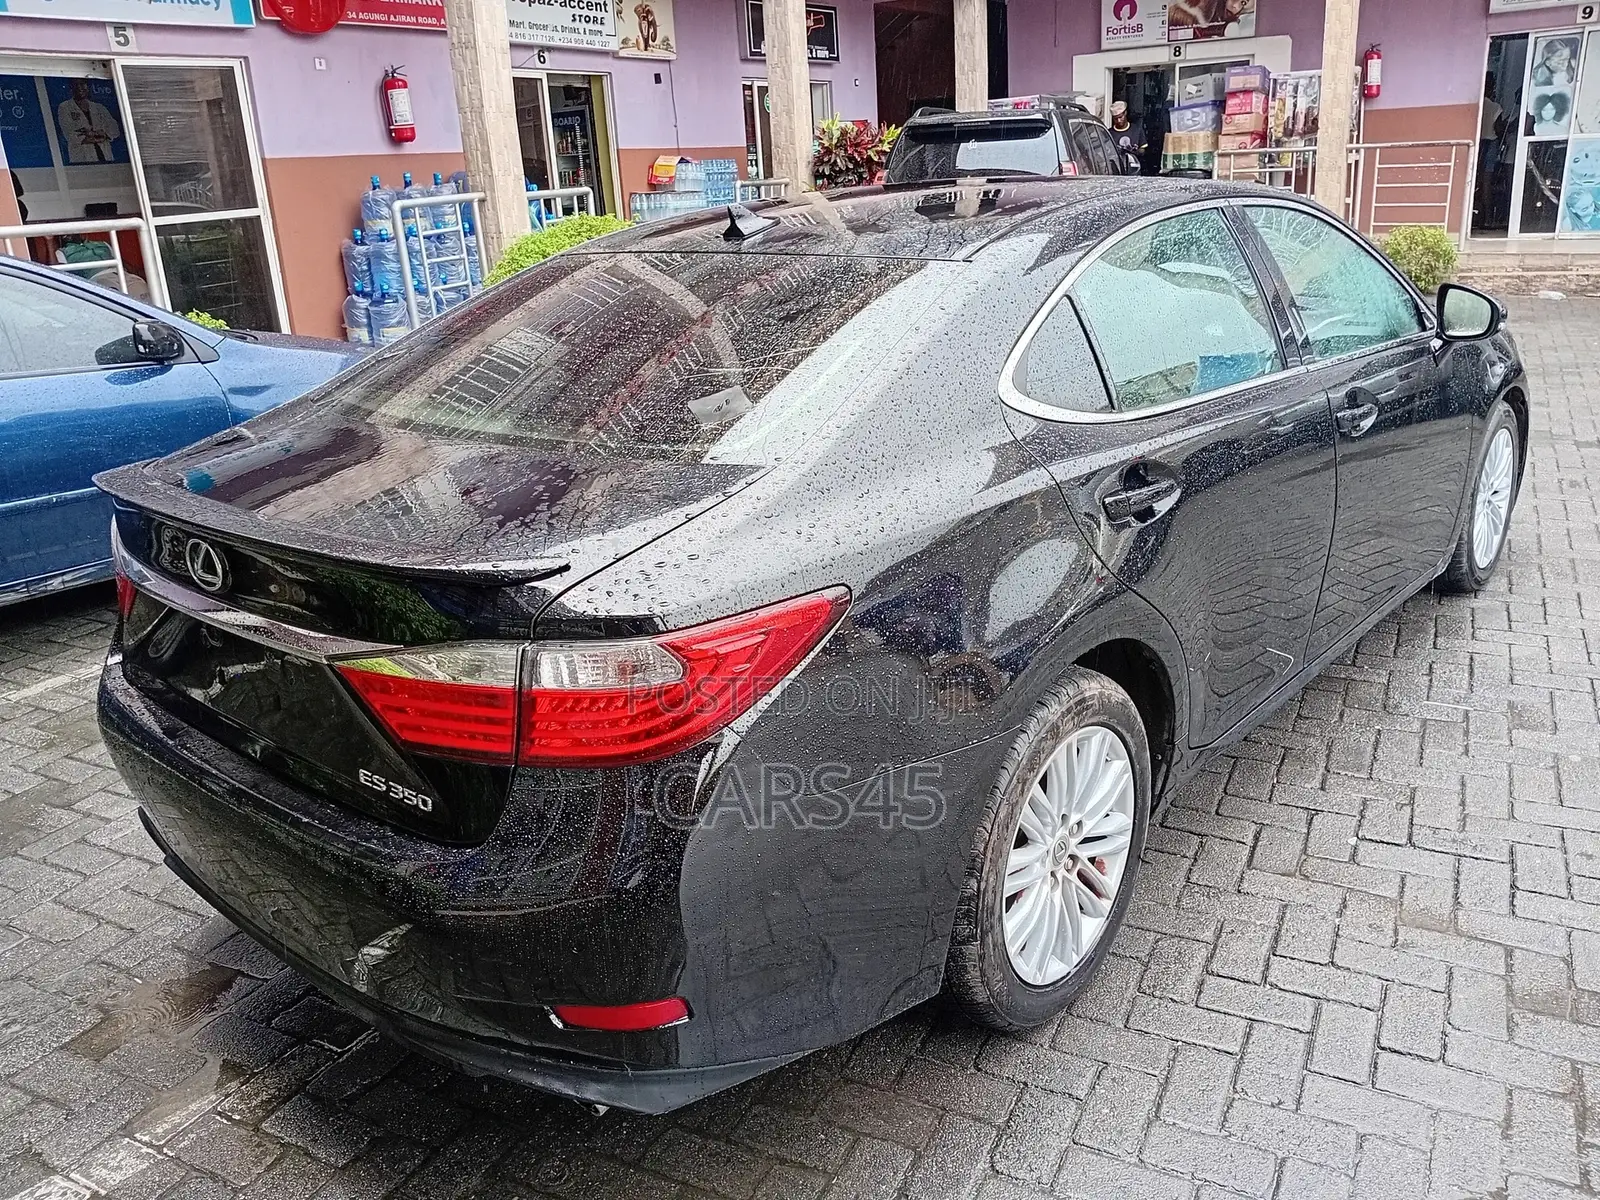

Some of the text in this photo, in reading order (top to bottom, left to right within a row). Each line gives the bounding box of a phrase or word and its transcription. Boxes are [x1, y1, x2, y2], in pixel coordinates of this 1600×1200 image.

[512, 0, 608, 13] paz-accent
[1581, 5, 1594, 20] 9
[346, 11, 357, 19] 34
[358, 12, 388, 21] AGUNGI
[390, 14, 417, 23] AJIRAN
[418, 17, 440, 26] ROAD,
[571, 13, 605, 26] STORE
[113, 26, 130, 47] 5
[1106, 23, 1144, 36] FortisB
[537, 49, 546, 64] 6
[1173, 46, 1182, 58] 8
[92, 83, 112, 95] Live
[359, 768, 432, 812] ES 350
